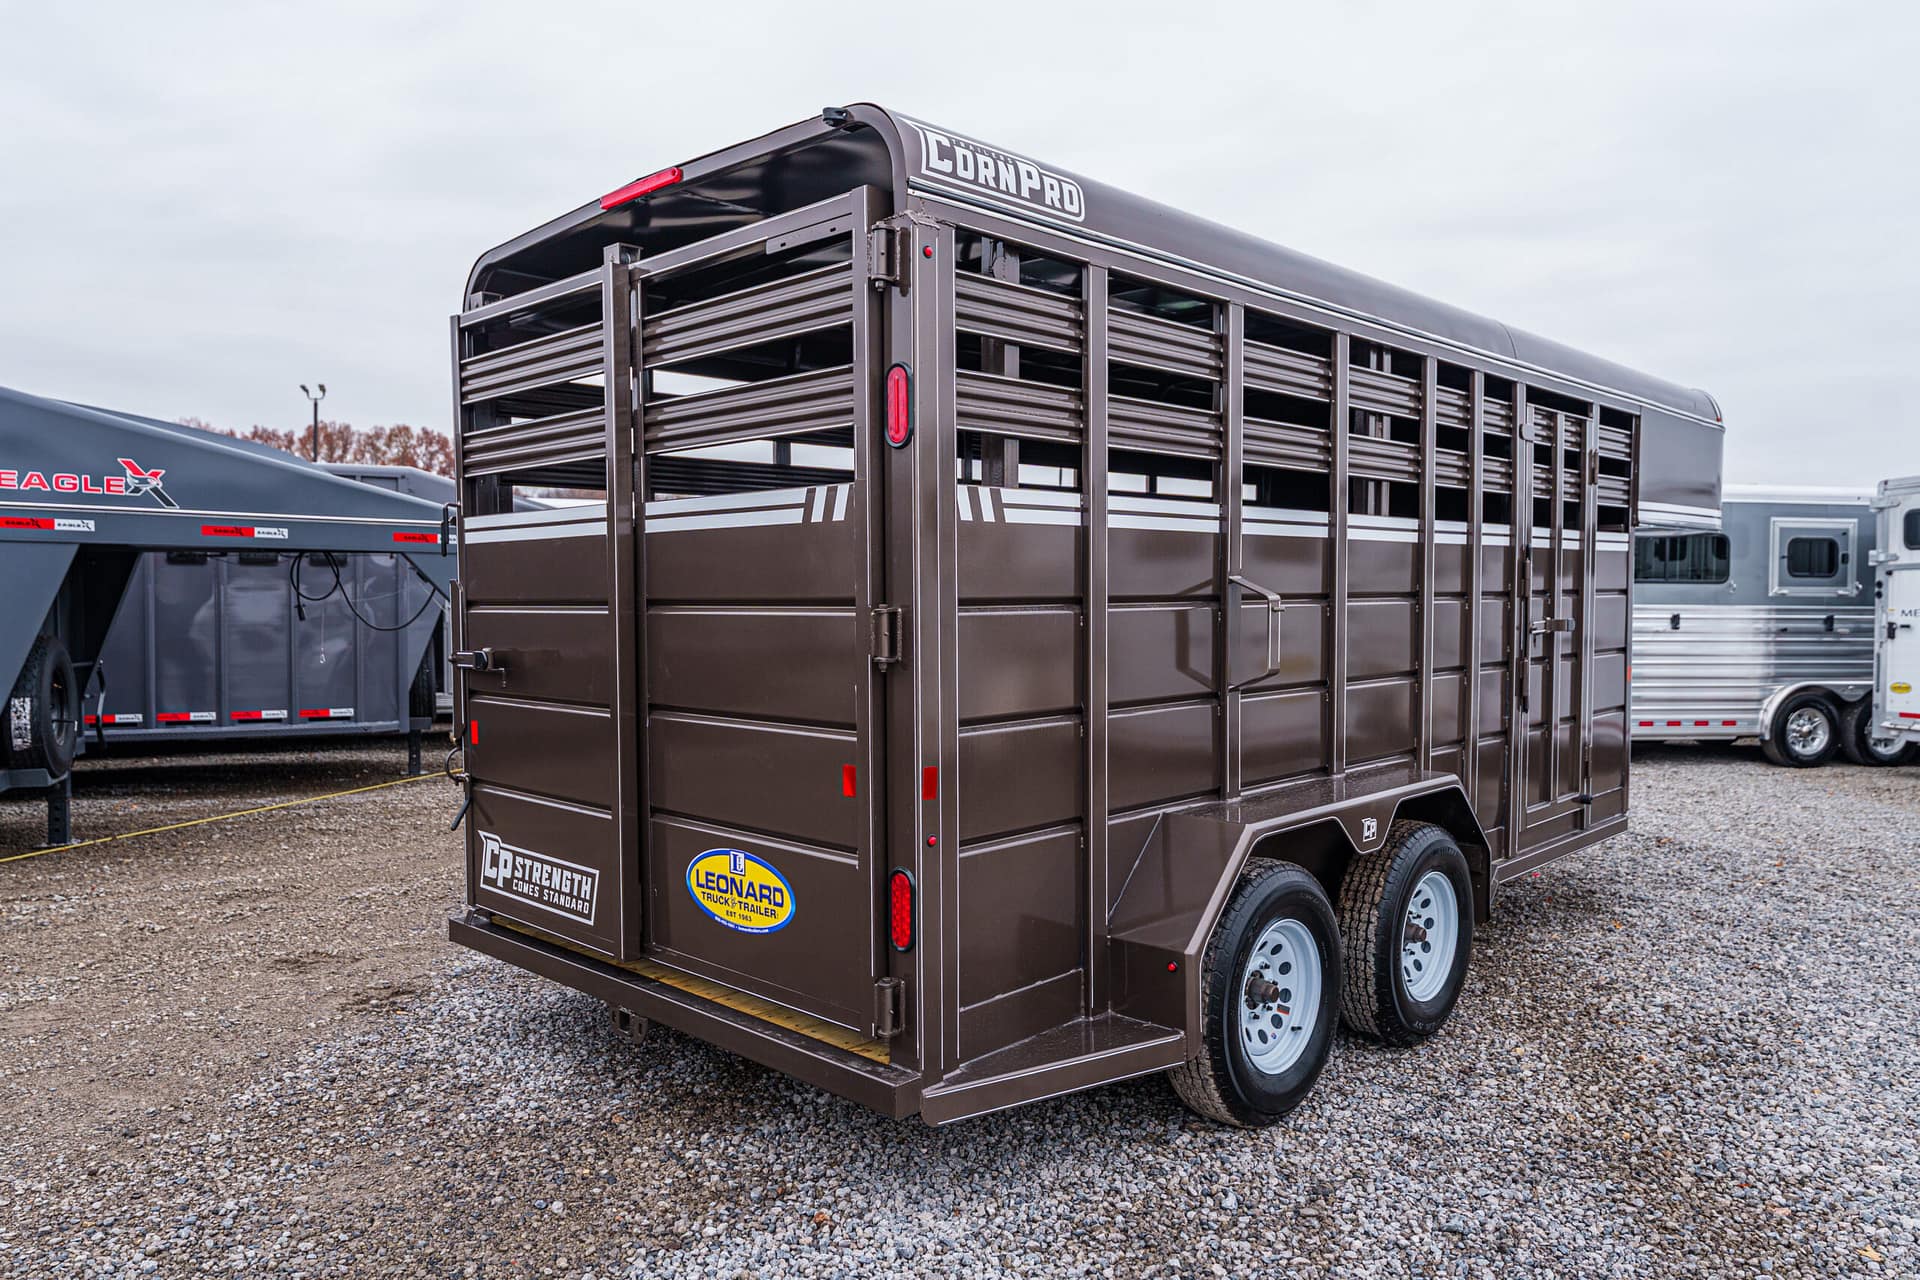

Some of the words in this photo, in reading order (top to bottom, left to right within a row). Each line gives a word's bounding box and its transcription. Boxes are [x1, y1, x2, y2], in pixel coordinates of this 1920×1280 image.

[484, 839, 513, 888] CP
[514, 856, 593, 900] STRENGTH
[512, 879, 540, 898] COMES
[543, 889, 590, 914] STANDARD
[696, 868, 784, 908] LEONARD
[701, 891, 730, 907] TRUCK
[737, 900, 777, 919] TRAILER
[726, 910, 737, 918] EST
